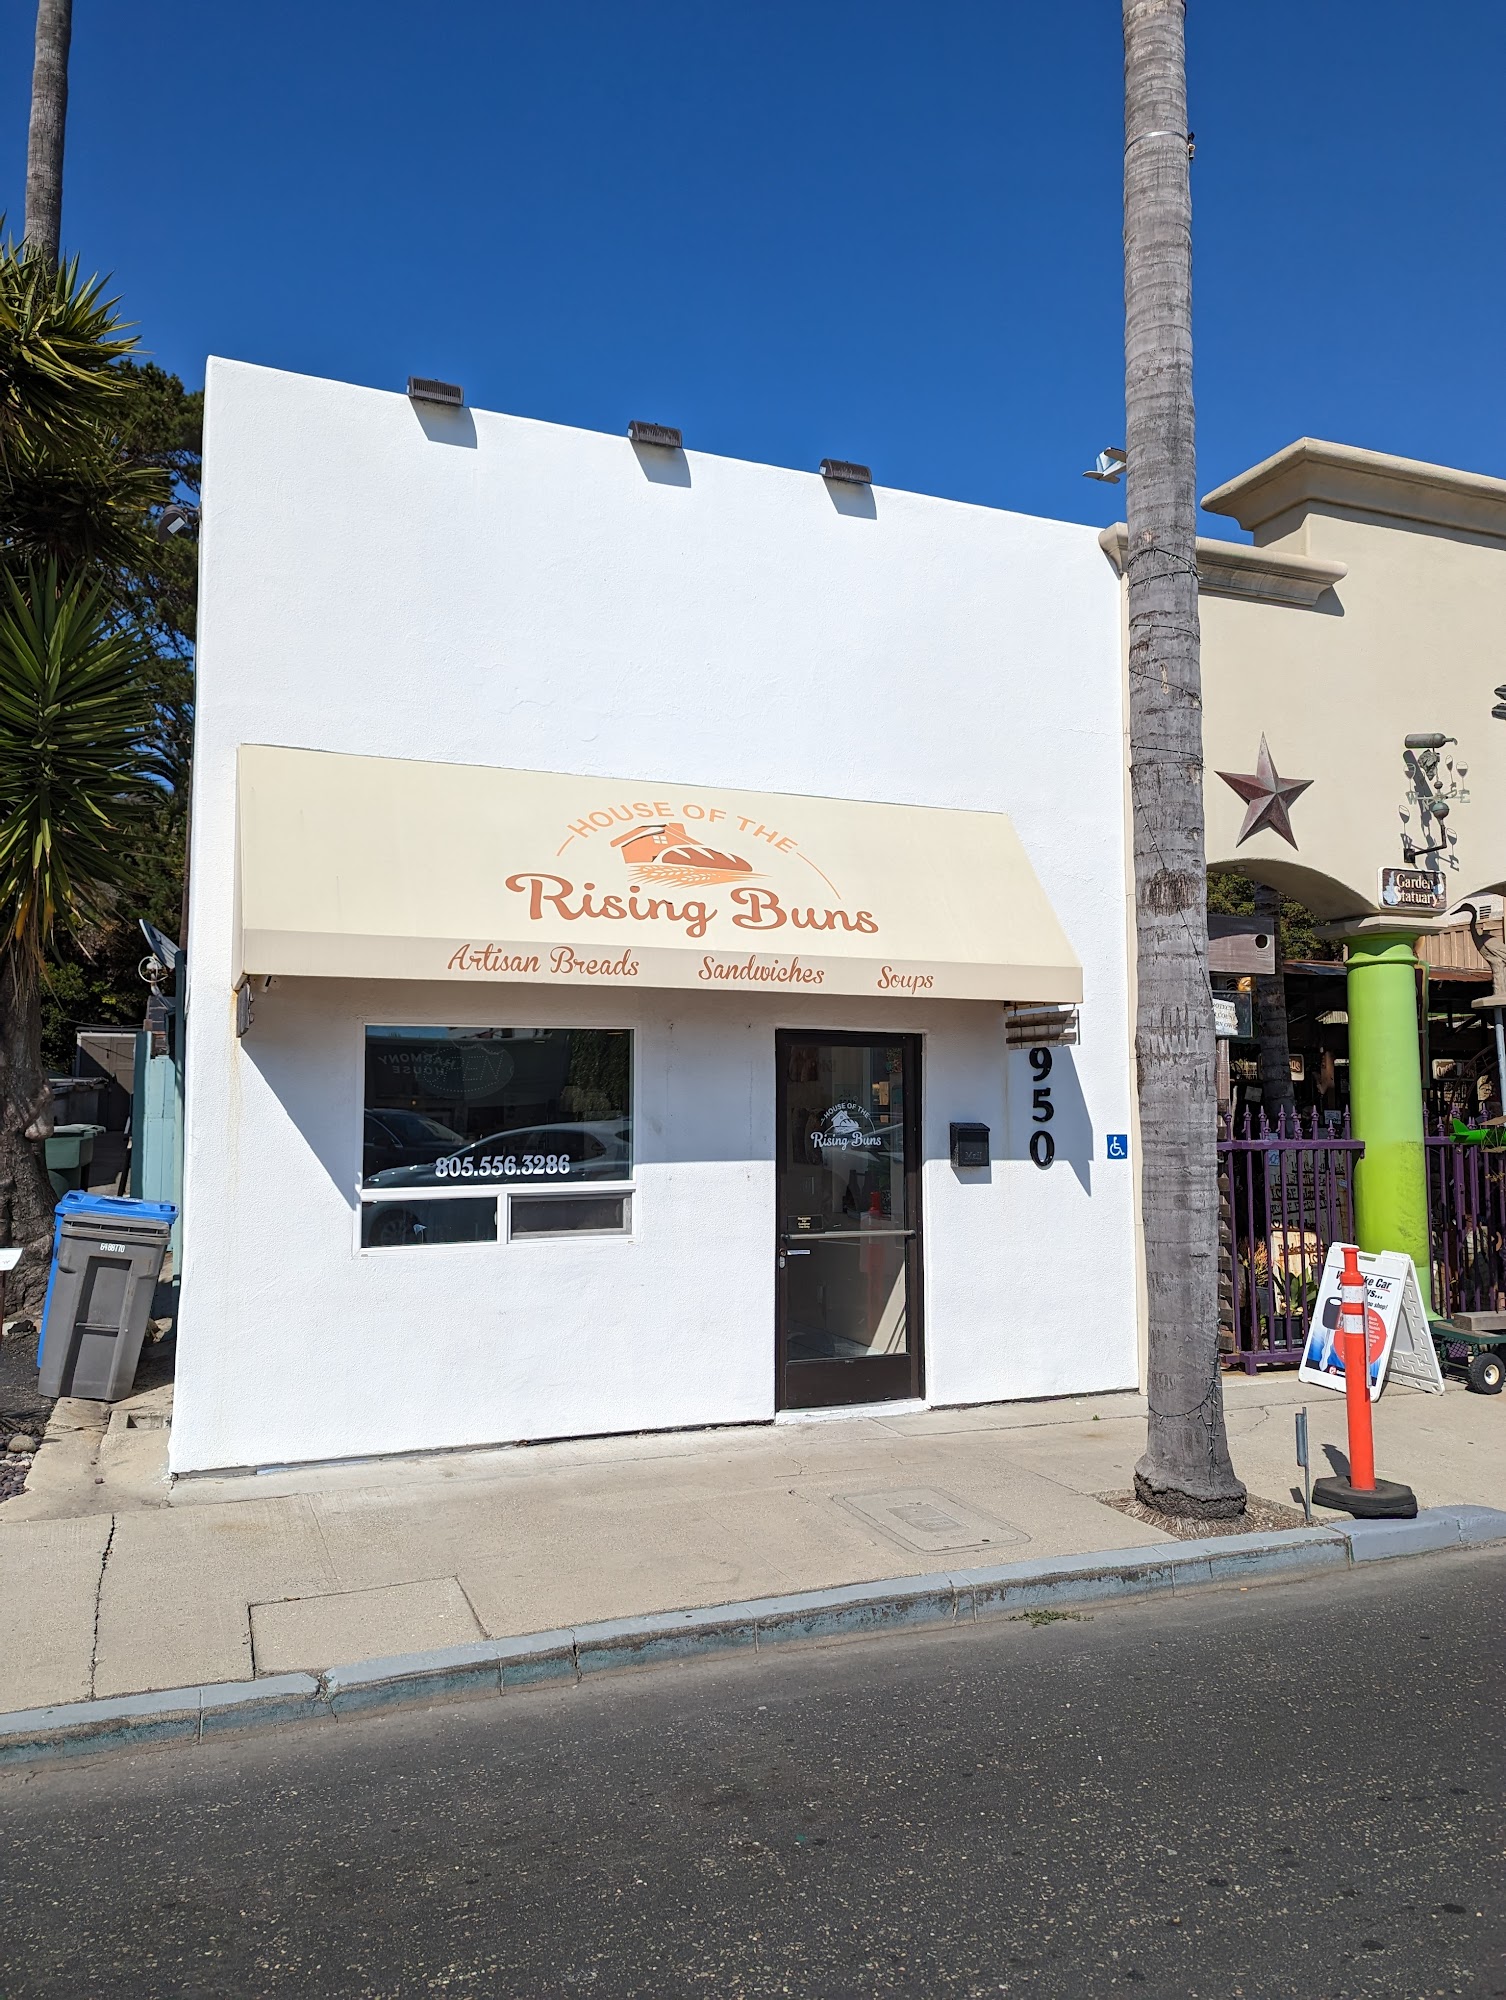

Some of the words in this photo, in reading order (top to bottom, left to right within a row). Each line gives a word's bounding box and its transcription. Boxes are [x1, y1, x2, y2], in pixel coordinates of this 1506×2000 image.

[567, 801, 674, 839] HOUSE
[682, 803, 727, 823] OF
[737, 815, 798, 854] THE
[1396, 874, 1434, 890] Garden
[505, 873, 717, 939] Rising
[730, 886, 879, 934] Buns
[1393, 886, 1438, 907] Statuary
[447, 943, 541, 974] Artisan
[550, 946, 640, 977] Breads
[698, 954, 826, 985] Sandwiches
[877, 965, 935, 993] Soups
[824, 1102, 846, 1119] HOUSE
[847, 1102, 858, 1110] OF
[858, 1105, 870, 1119] THE
[1028, 1046, 1056, 1170] 950
[810, 1131, 850, 1151] Rising
[851, 1131, 882, 1147] Buns
[435, 1154, 571, 1178] 805.556.3286
[1375, 1278, 1393, 1290] Car
